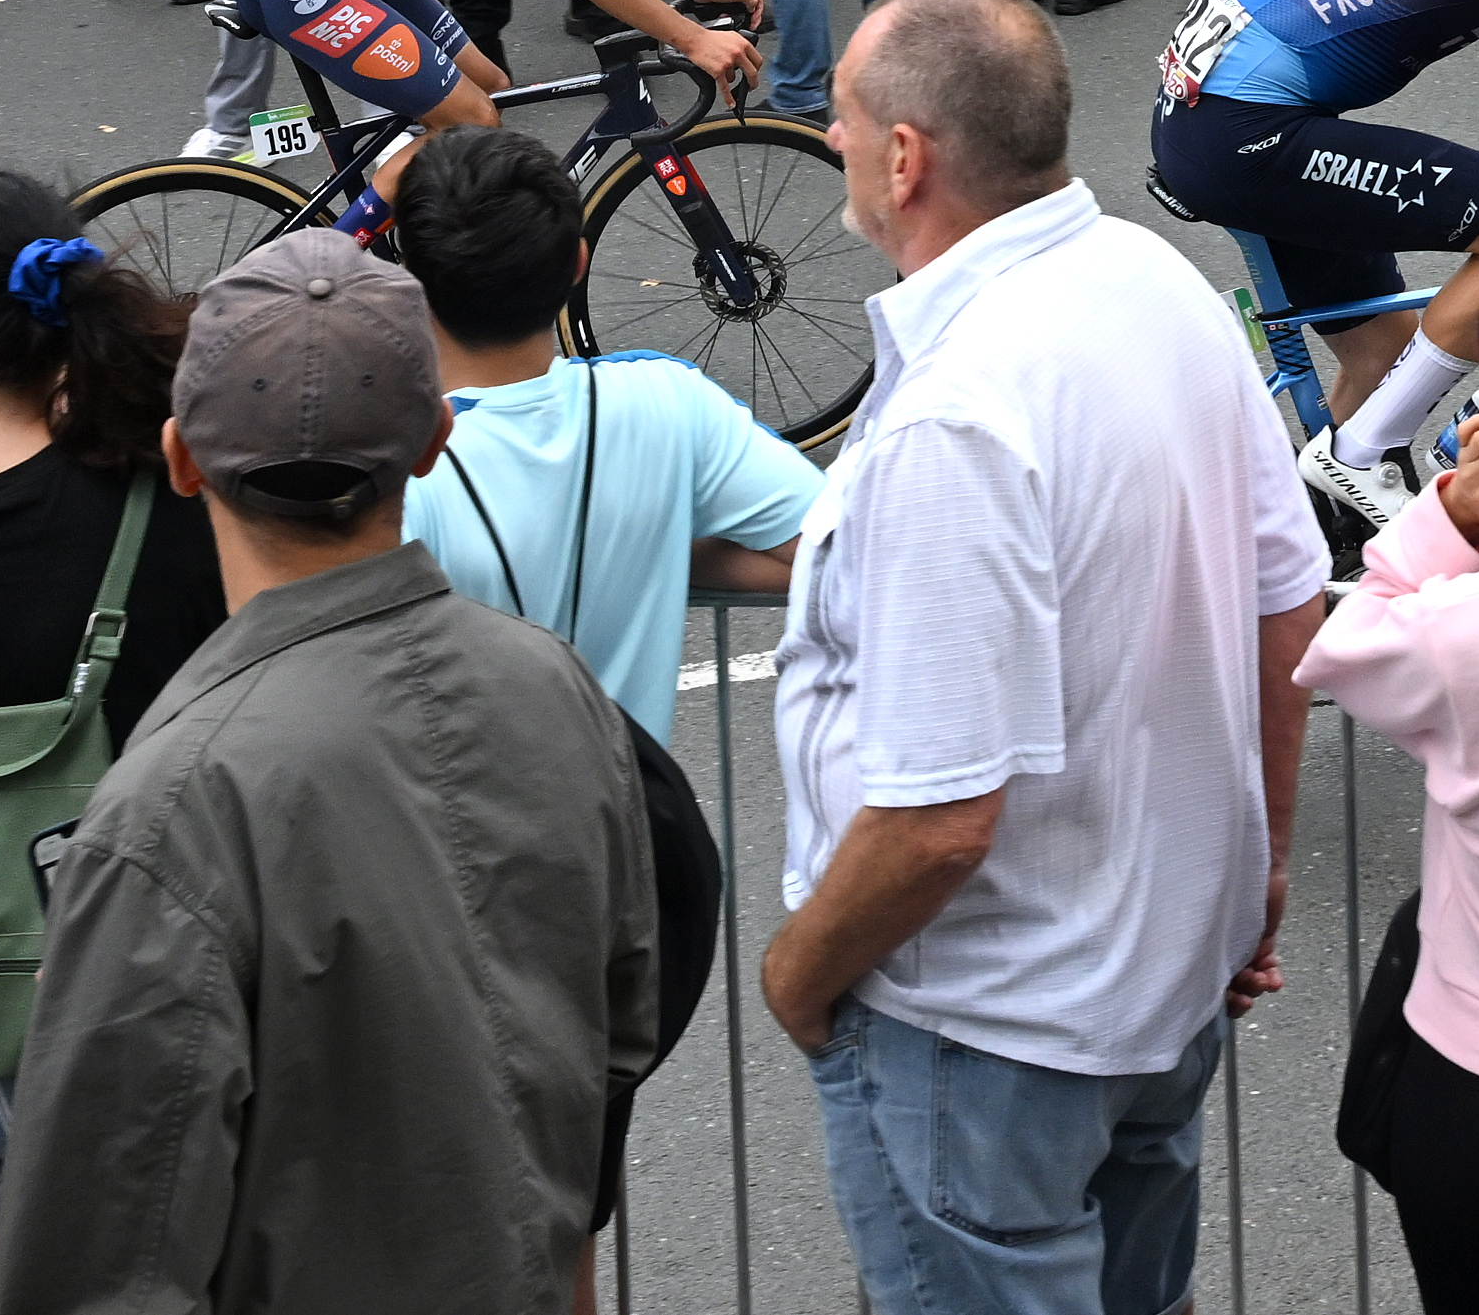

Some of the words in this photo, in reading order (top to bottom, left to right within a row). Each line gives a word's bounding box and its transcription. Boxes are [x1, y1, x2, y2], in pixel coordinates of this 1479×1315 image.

[328, 4, 373, 34] PIC
[369, 42, 414, 73] postnl
[551, 79, 602, 94] LAPIERRE
[264, 122, 307, 157] 195
[1301, 149, 1389, 197] ISRAEL
[1311, 449, 1390, 524] SPECIALIZED
